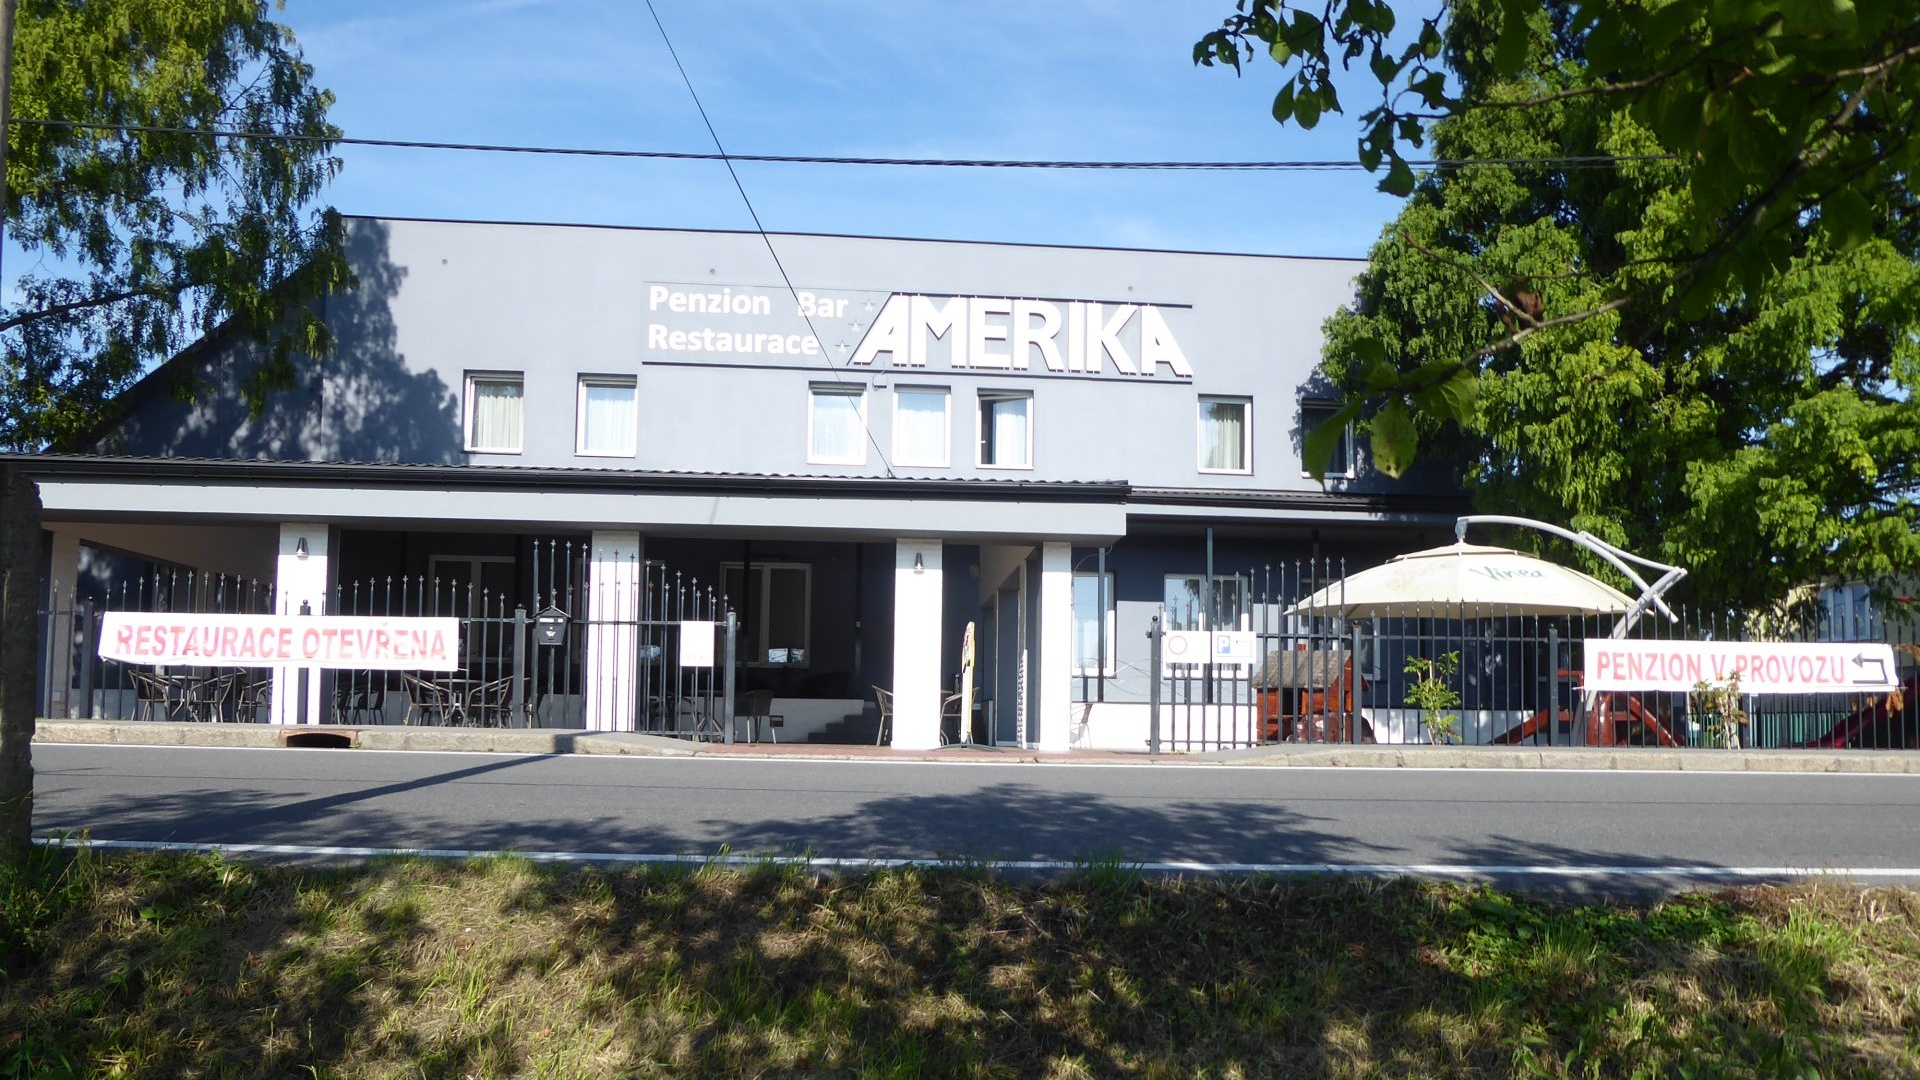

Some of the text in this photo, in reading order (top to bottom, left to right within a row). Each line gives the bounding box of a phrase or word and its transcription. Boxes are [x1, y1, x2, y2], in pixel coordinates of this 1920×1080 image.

[649, 285, 849, 318] Penzion Bar
[648, 323, 819, 355] Restaurace
[853, 294, 1194, 378] AMERIKA
[1468, 565, 1547, 581] Vinea
[116, 624, 293, 658] RESTAURACE
[302, 621, 447, 660] OTEVŘENA
[1597, 651, 1845, 684] PENZION V PROVOZU
